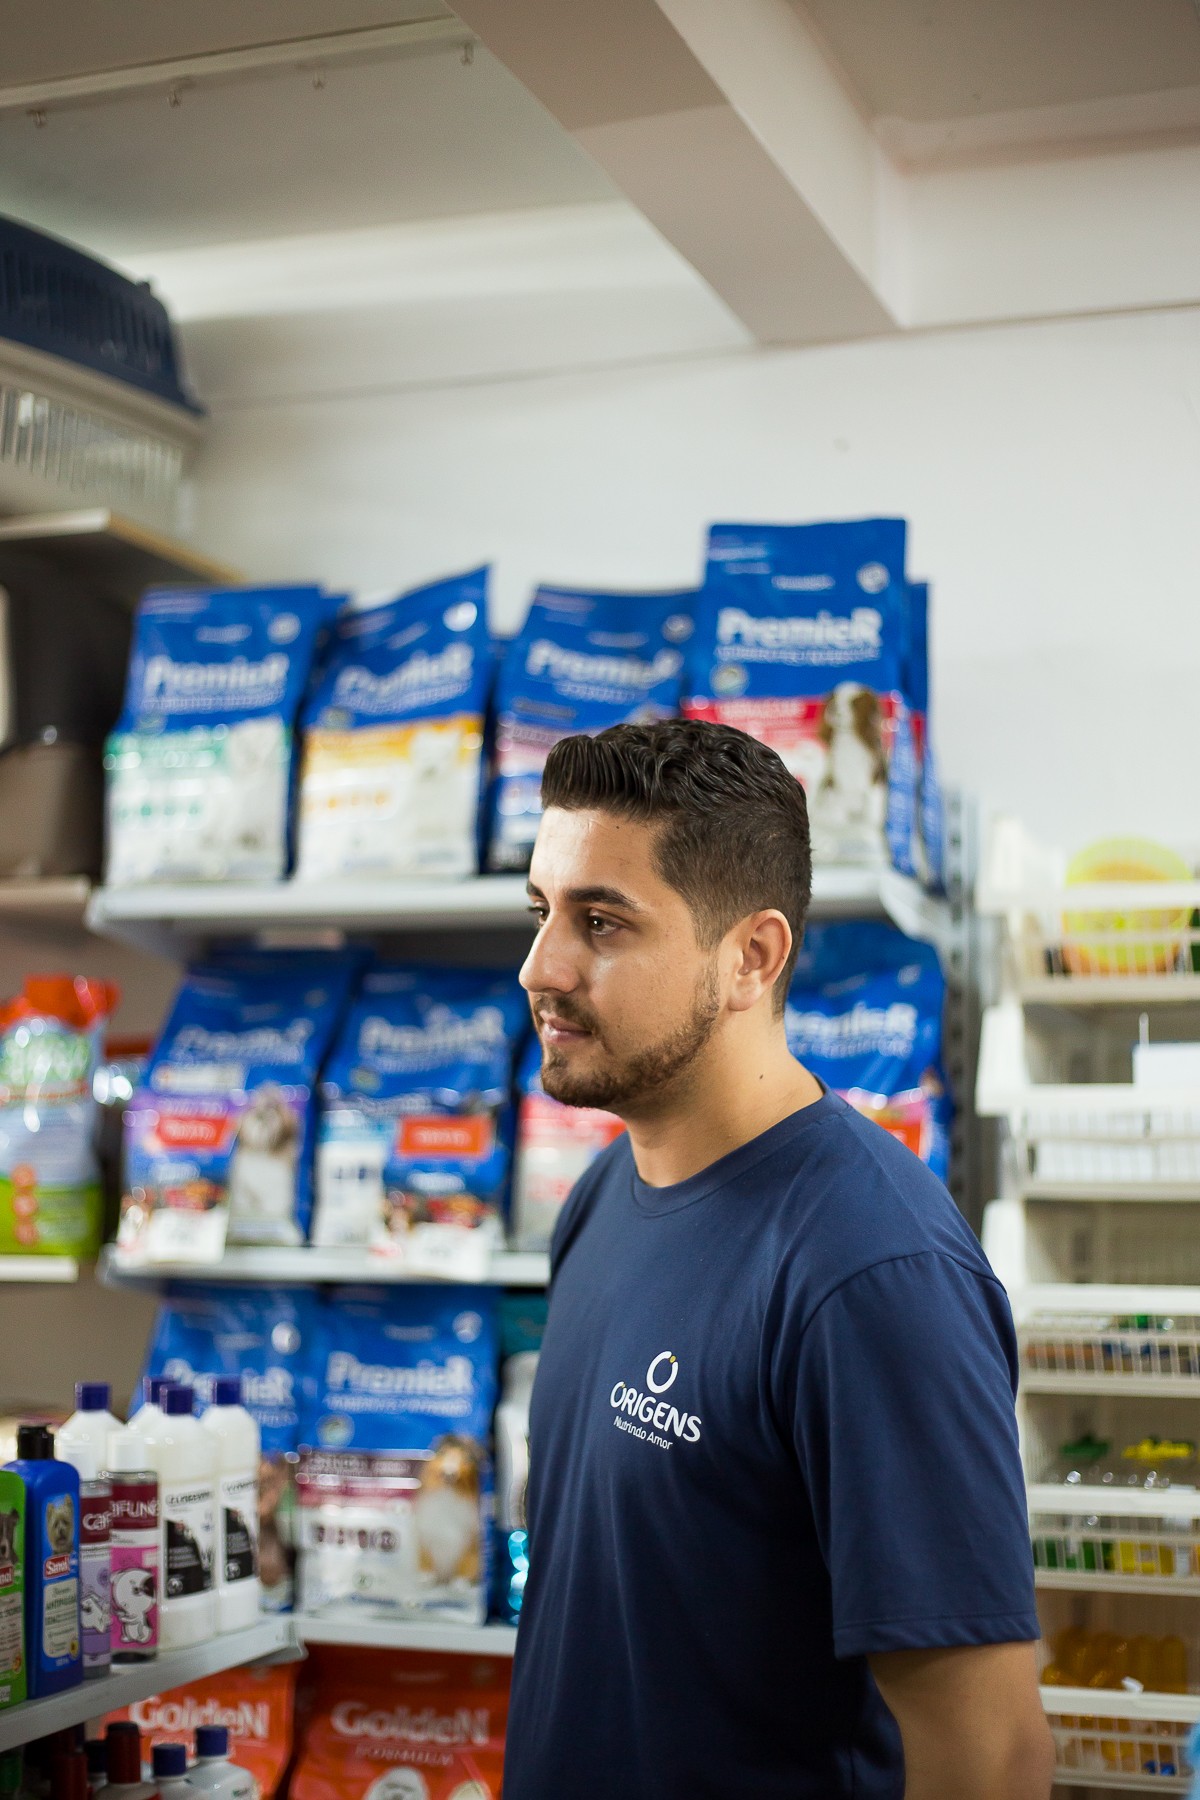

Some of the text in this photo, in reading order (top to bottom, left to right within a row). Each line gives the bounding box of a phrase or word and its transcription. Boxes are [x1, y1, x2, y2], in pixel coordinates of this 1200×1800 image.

[610, 1381, 702, 1442] ORIGENS
[613, 1415, 673, 1450] Nutrindo Amor
[128, 1697, 270, 1739] GoldeN
[330, 1701, 490, 1746] GoldeN
